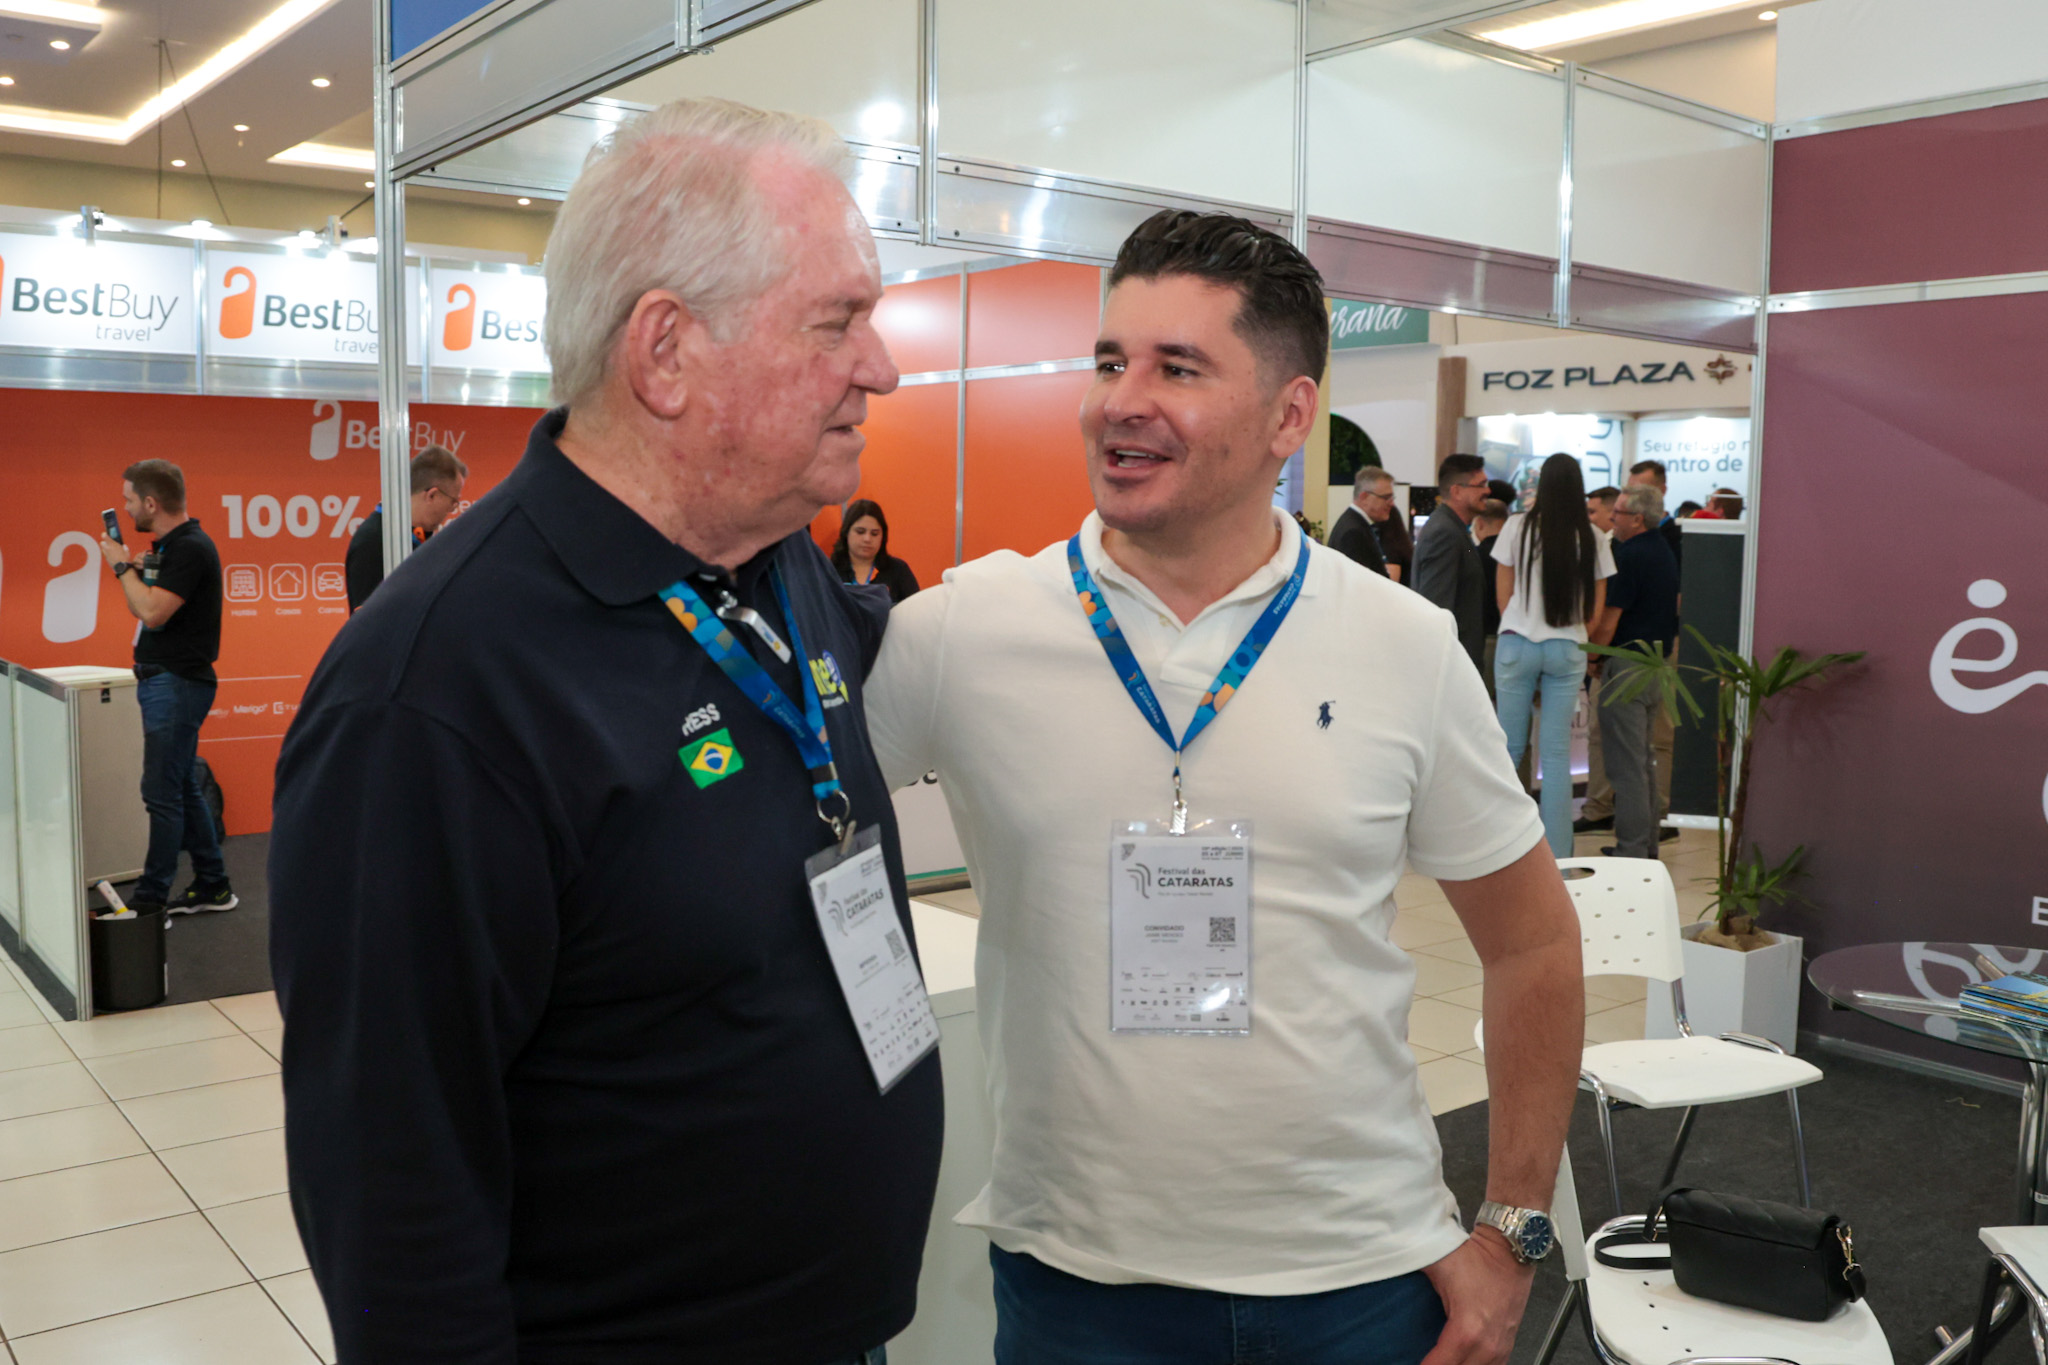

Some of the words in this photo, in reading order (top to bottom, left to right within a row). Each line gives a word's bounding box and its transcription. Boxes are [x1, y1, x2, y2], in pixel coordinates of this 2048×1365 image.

[12, 277, 179, 331] BestBuy
[263, 295, 379, 334] BestBu
[96, 324, 151, 342] travel
[334, 337, 379, 354] trave
[1483, 370, 1554, 391] FOZ
[1564, 361, 1695, 387] PLAZA
[1643, 440, 1672, 452] Seu
[1716, 453, 1743, 472] de
[222, 494, 366, 539] 100%
[1158, 867, 1190, 875] Festival
[1191, 867, 1206, 875] das
[1157, 877, 1234, 887] CATARATAS
